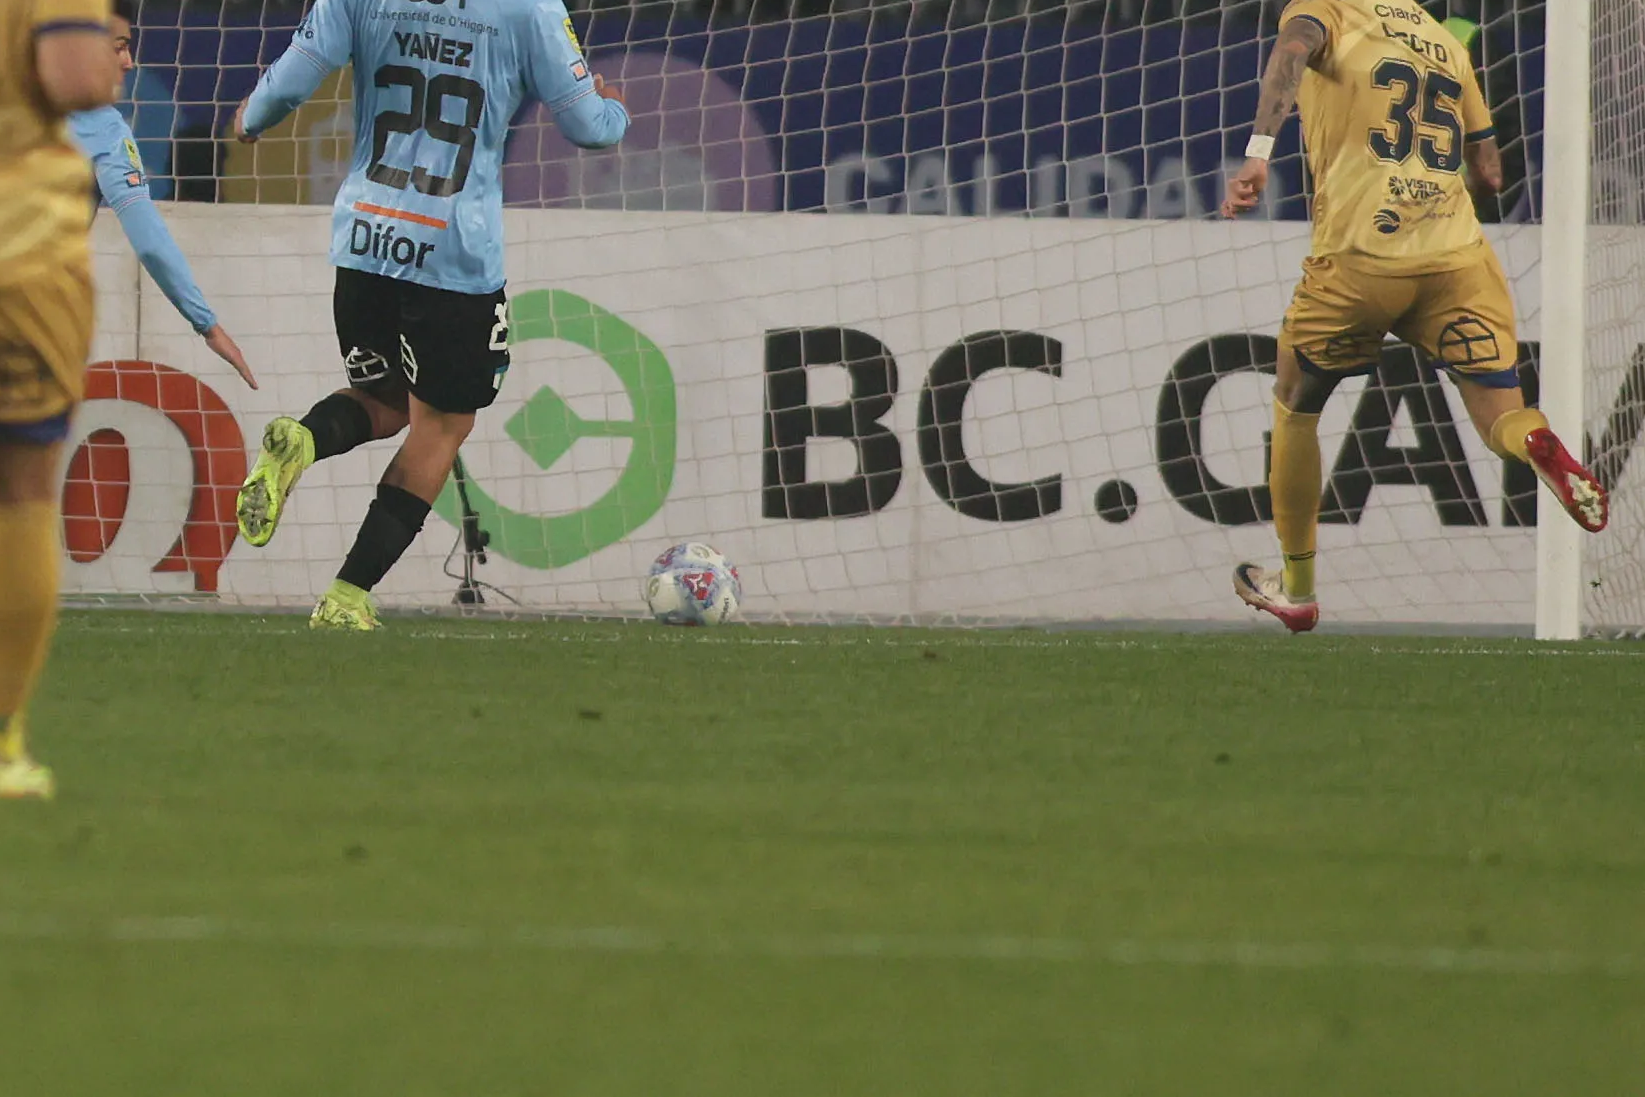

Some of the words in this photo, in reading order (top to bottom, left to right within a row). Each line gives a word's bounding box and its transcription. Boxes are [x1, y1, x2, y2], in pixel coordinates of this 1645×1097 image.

[432, 14, 446, 25] de
[448, 15, 500, 37] O'Higgins
[1374, 4, 1422, 25] Claro
[395, 30, 473, 68] YAÑEZ
[365, 63, 486, 198] 29
[1366, 57, 1463, 175] 35
[350, 217, 435, 269] Difor
[489, 302, 508, 351] 2
